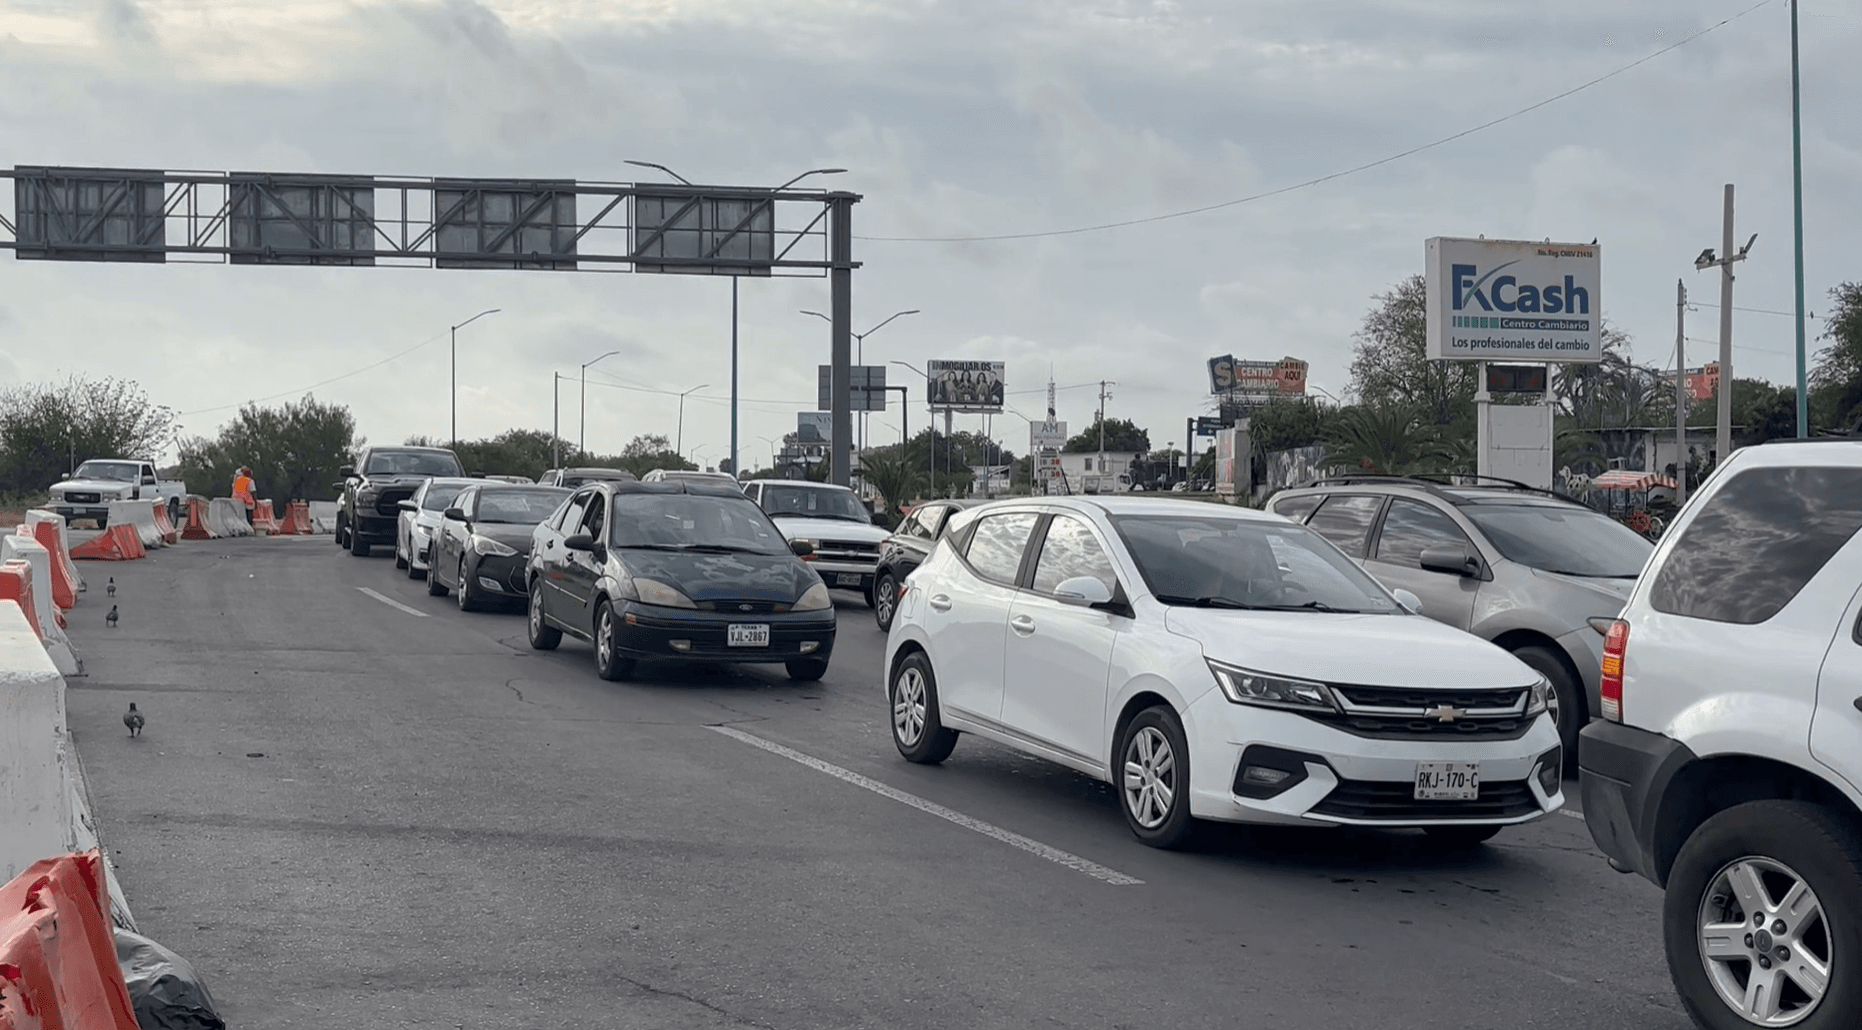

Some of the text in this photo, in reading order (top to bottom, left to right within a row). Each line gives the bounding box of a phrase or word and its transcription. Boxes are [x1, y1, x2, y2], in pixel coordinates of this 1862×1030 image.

[1502, 319, 1588, 331] Centro Cambiario
[1452, 336, 1590, 351] Los profesionales del cambio
[1241, 367, 1273, 377] CENTRO
[1418, 771, 1478, 789] RKJ-170-C
